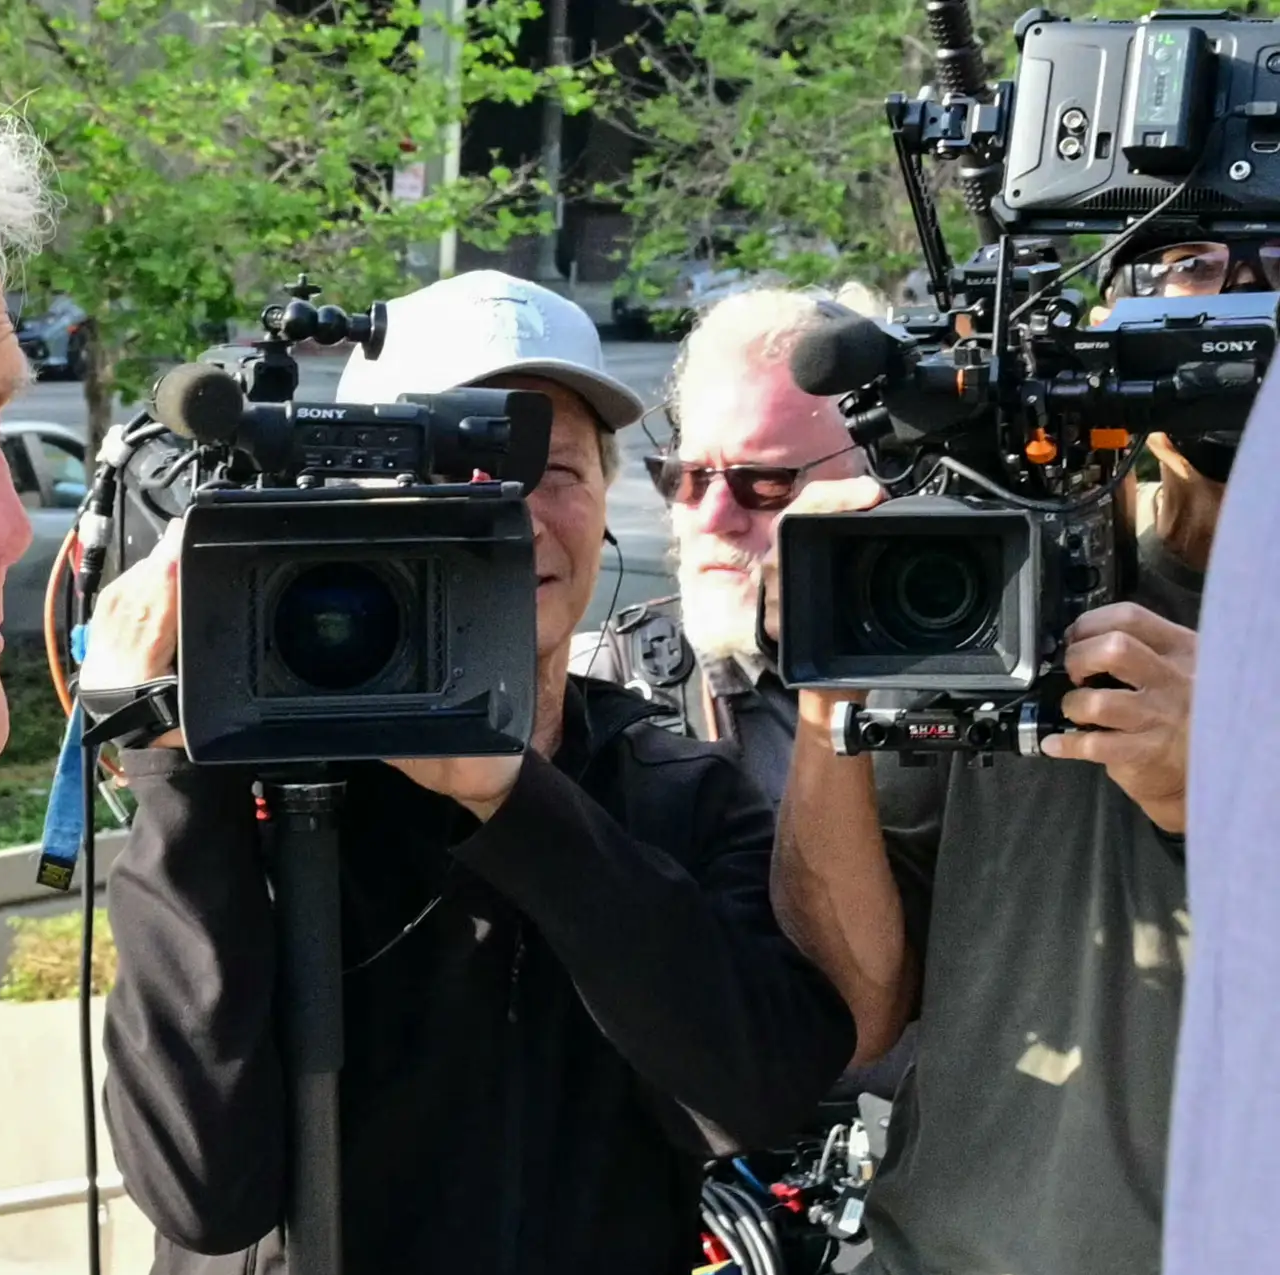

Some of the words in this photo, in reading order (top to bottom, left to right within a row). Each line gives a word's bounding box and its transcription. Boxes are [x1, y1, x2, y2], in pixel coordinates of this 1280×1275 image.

[1202, 341, 1257, 353] SONY
[296, 407, 347, 419] SONY
[909, 724, 955, 735] SHAPE
